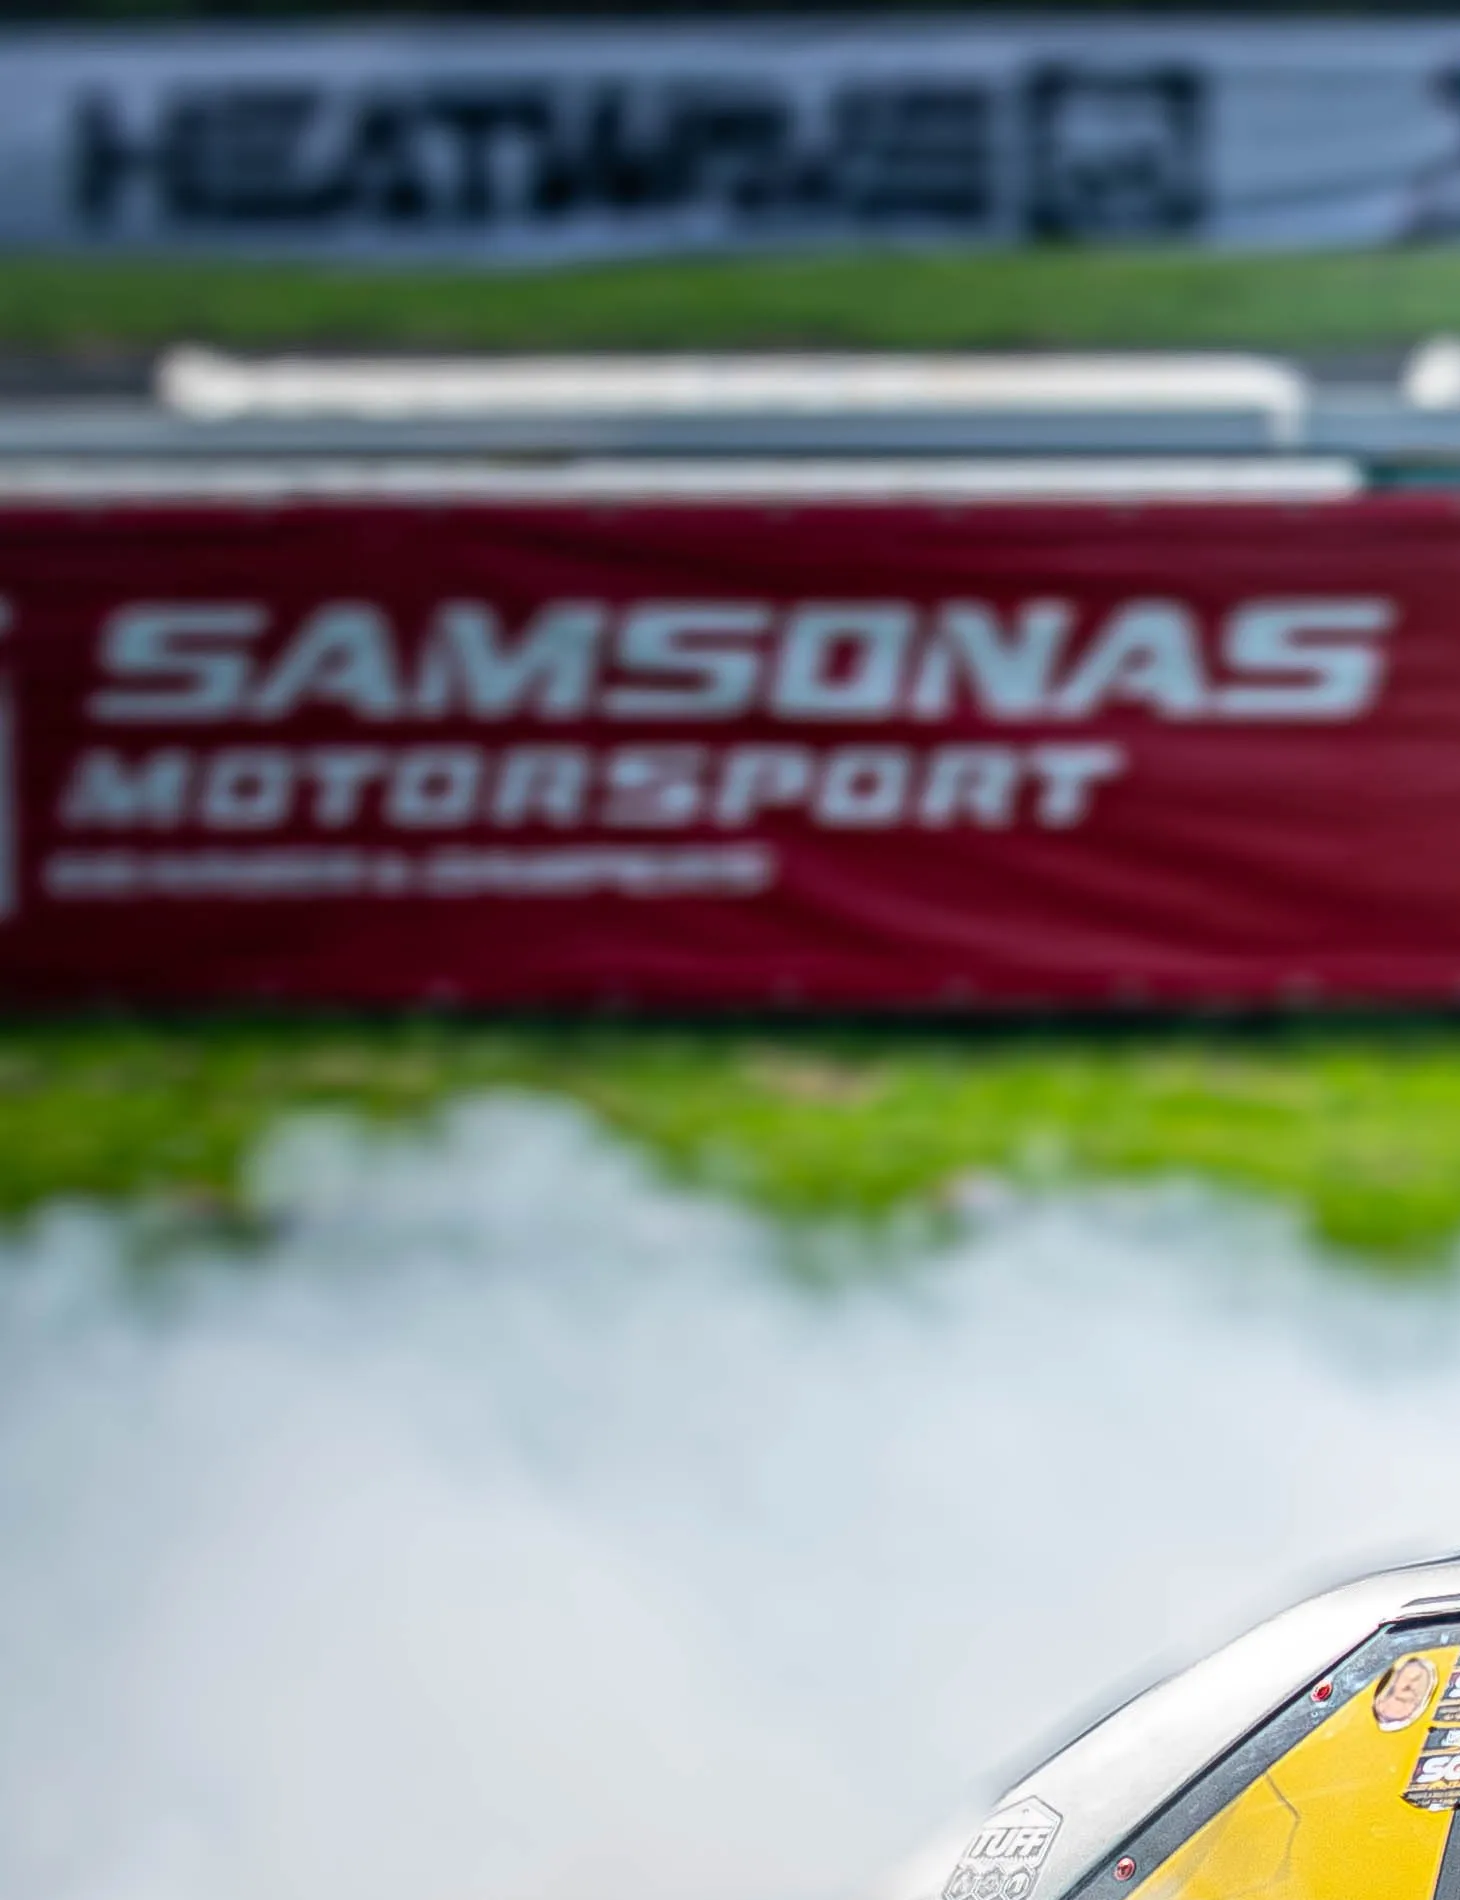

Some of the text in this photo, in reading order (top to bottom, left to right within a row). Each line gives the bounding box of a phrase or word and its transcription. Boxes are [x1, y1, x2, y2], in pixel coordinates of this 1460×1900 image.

[85, 602, 1398, 720] SAMSONAS
[60, 743, 1125, 828] MOTORSPORT
[969, 1828, 1054, 1858] TUFF
